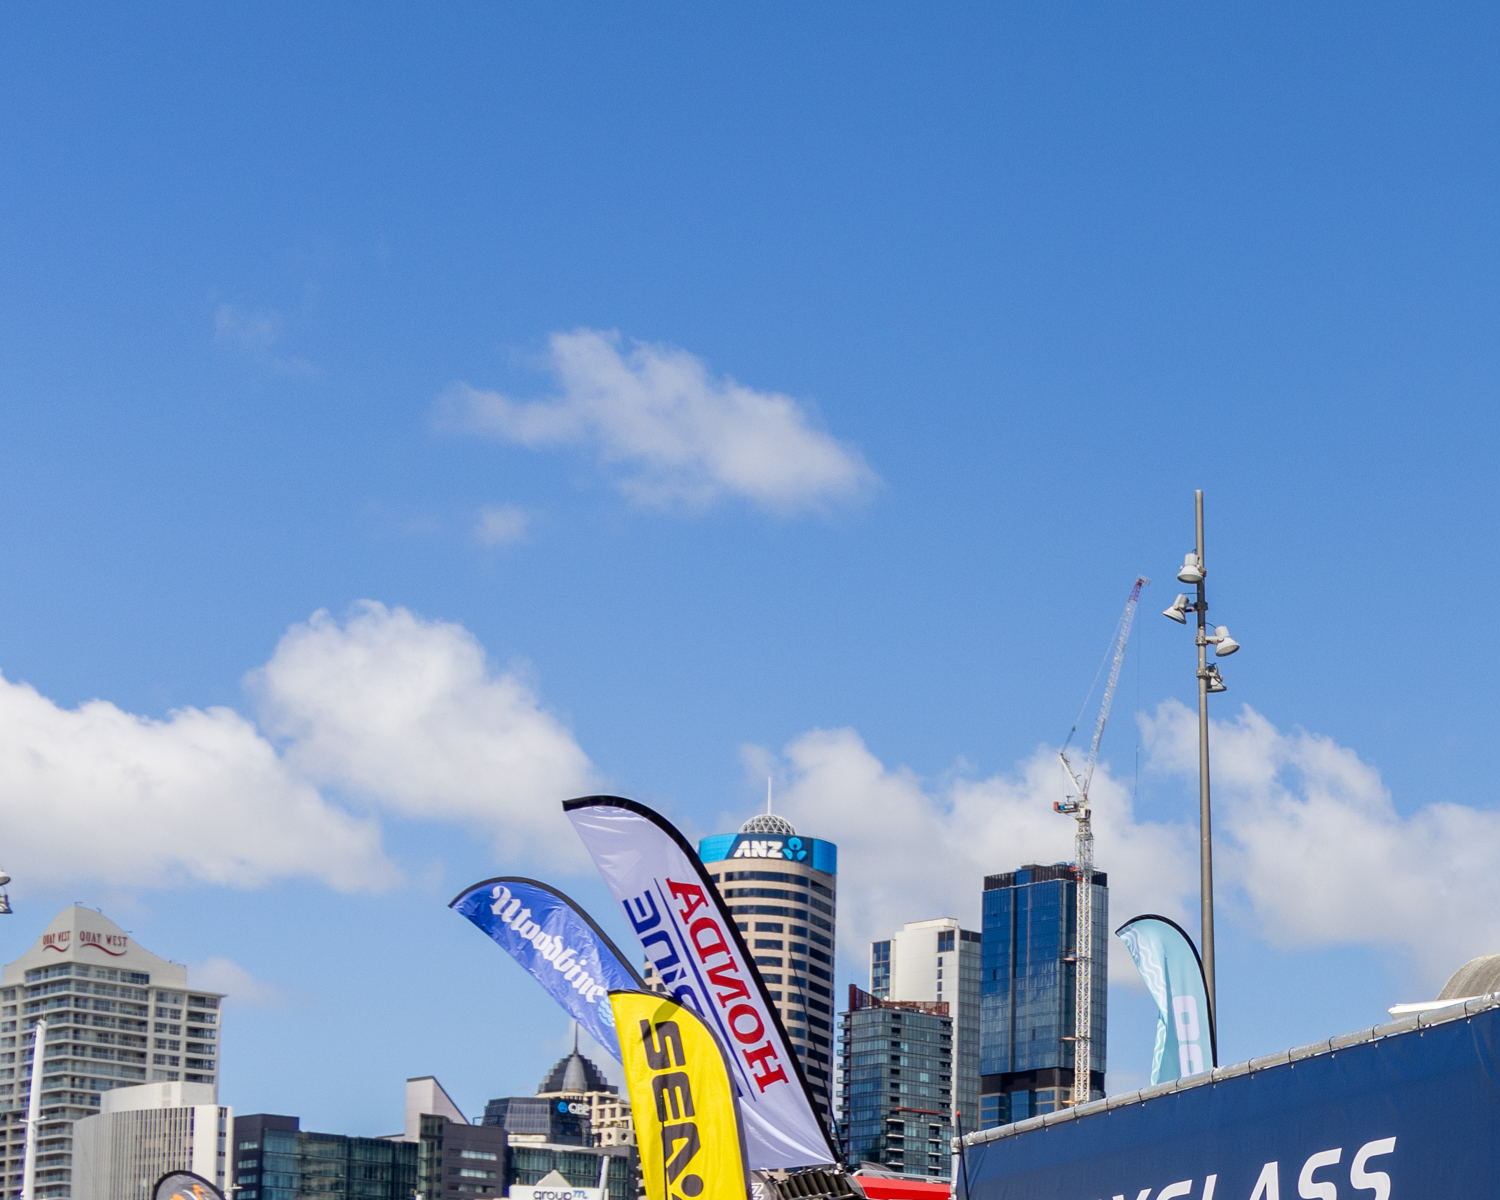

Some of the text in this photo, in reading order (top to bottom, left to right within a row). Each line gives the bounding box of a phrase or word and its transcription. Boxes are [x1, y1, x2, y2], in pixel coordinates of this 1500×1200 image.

[733, 840, 784, 859] ANZ
[42, 930, 71, 946] QUAY WEST
[79, 931, 128, 948] QUAY WEST
[489, 885, 606, 1004] Woodbine
